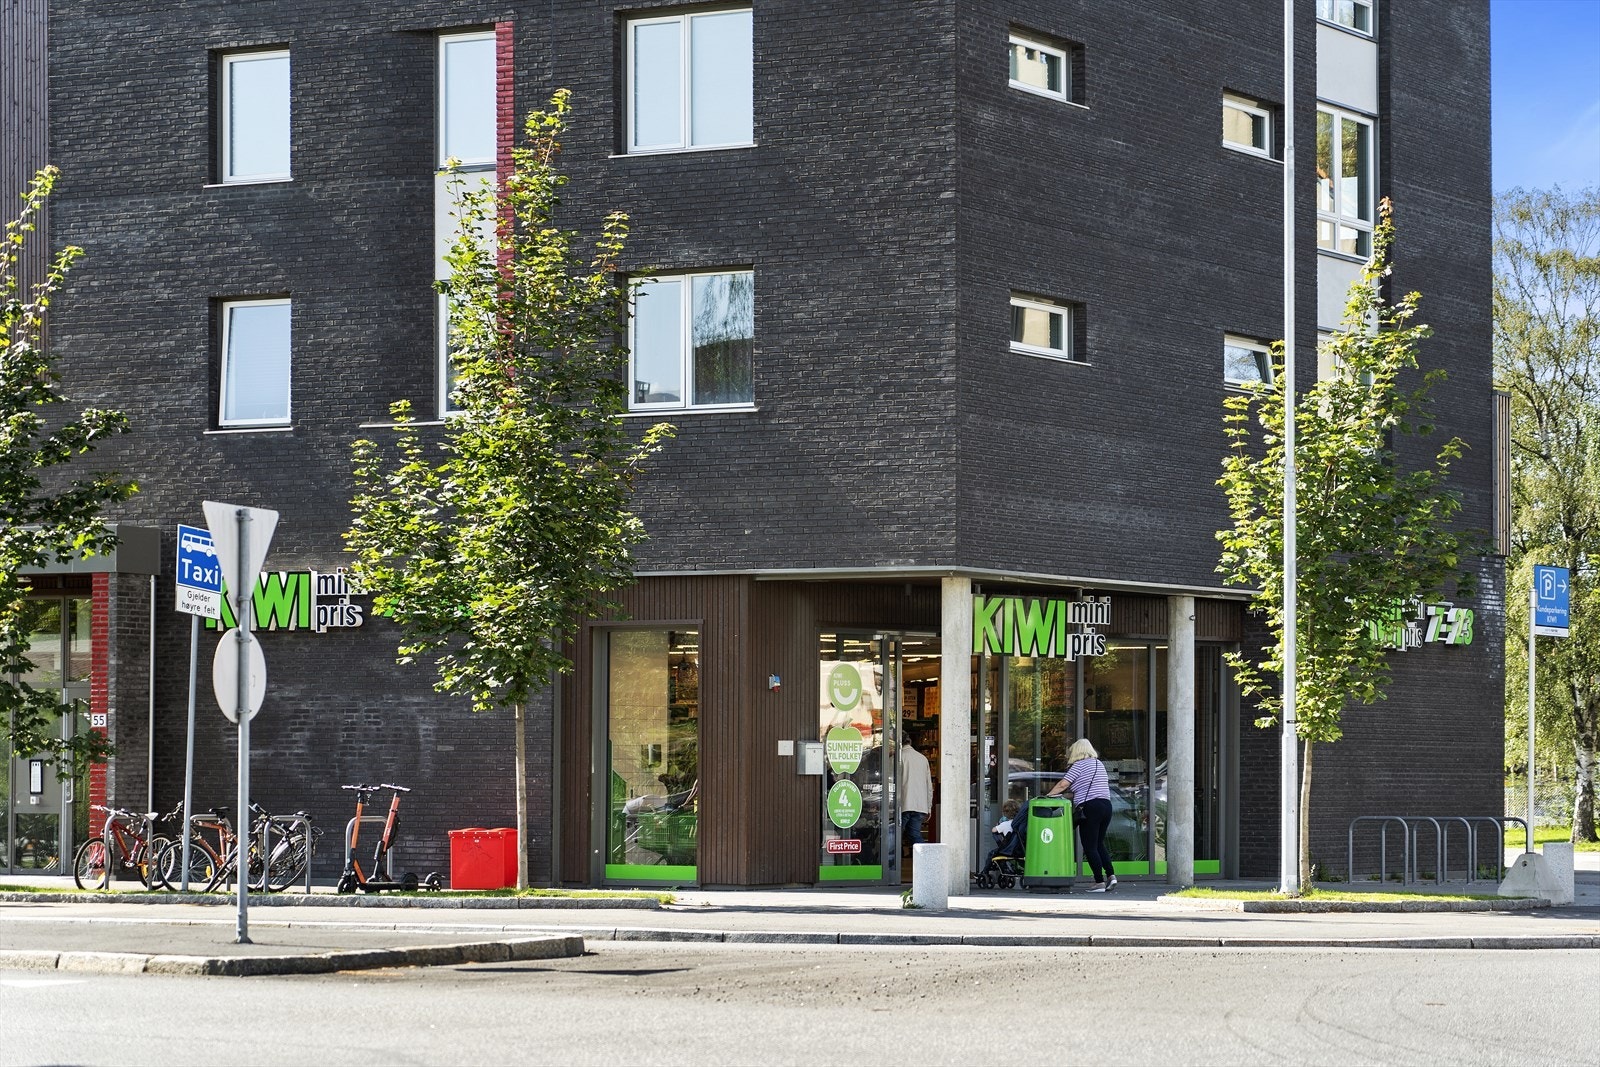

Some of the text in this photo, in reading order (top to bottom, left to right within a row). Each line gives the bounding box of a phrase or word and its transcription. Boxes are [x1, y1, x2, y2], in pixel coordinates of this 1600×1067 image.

[181, 558, 219, 585] Taxi
[187, 590, 211, 602] Gjelder
[204, 571, 312, 630] WI
[181, 600, 216, 615] høyre felt
[316, 598, 361, 633] pris
[1070, 596, 1112, 625] mini
[1537, 605, 1567, 617] Kundeparkering
[973, 595, 1067, 658] KIWI
[1070, 627, 1107, 661] pris
[93, 715, 105, 726] 55
[827, 742, 863, 752] SUNNHET
[838, 789, 852, 807] 4.
[829, 842, 859, 850] First Price
